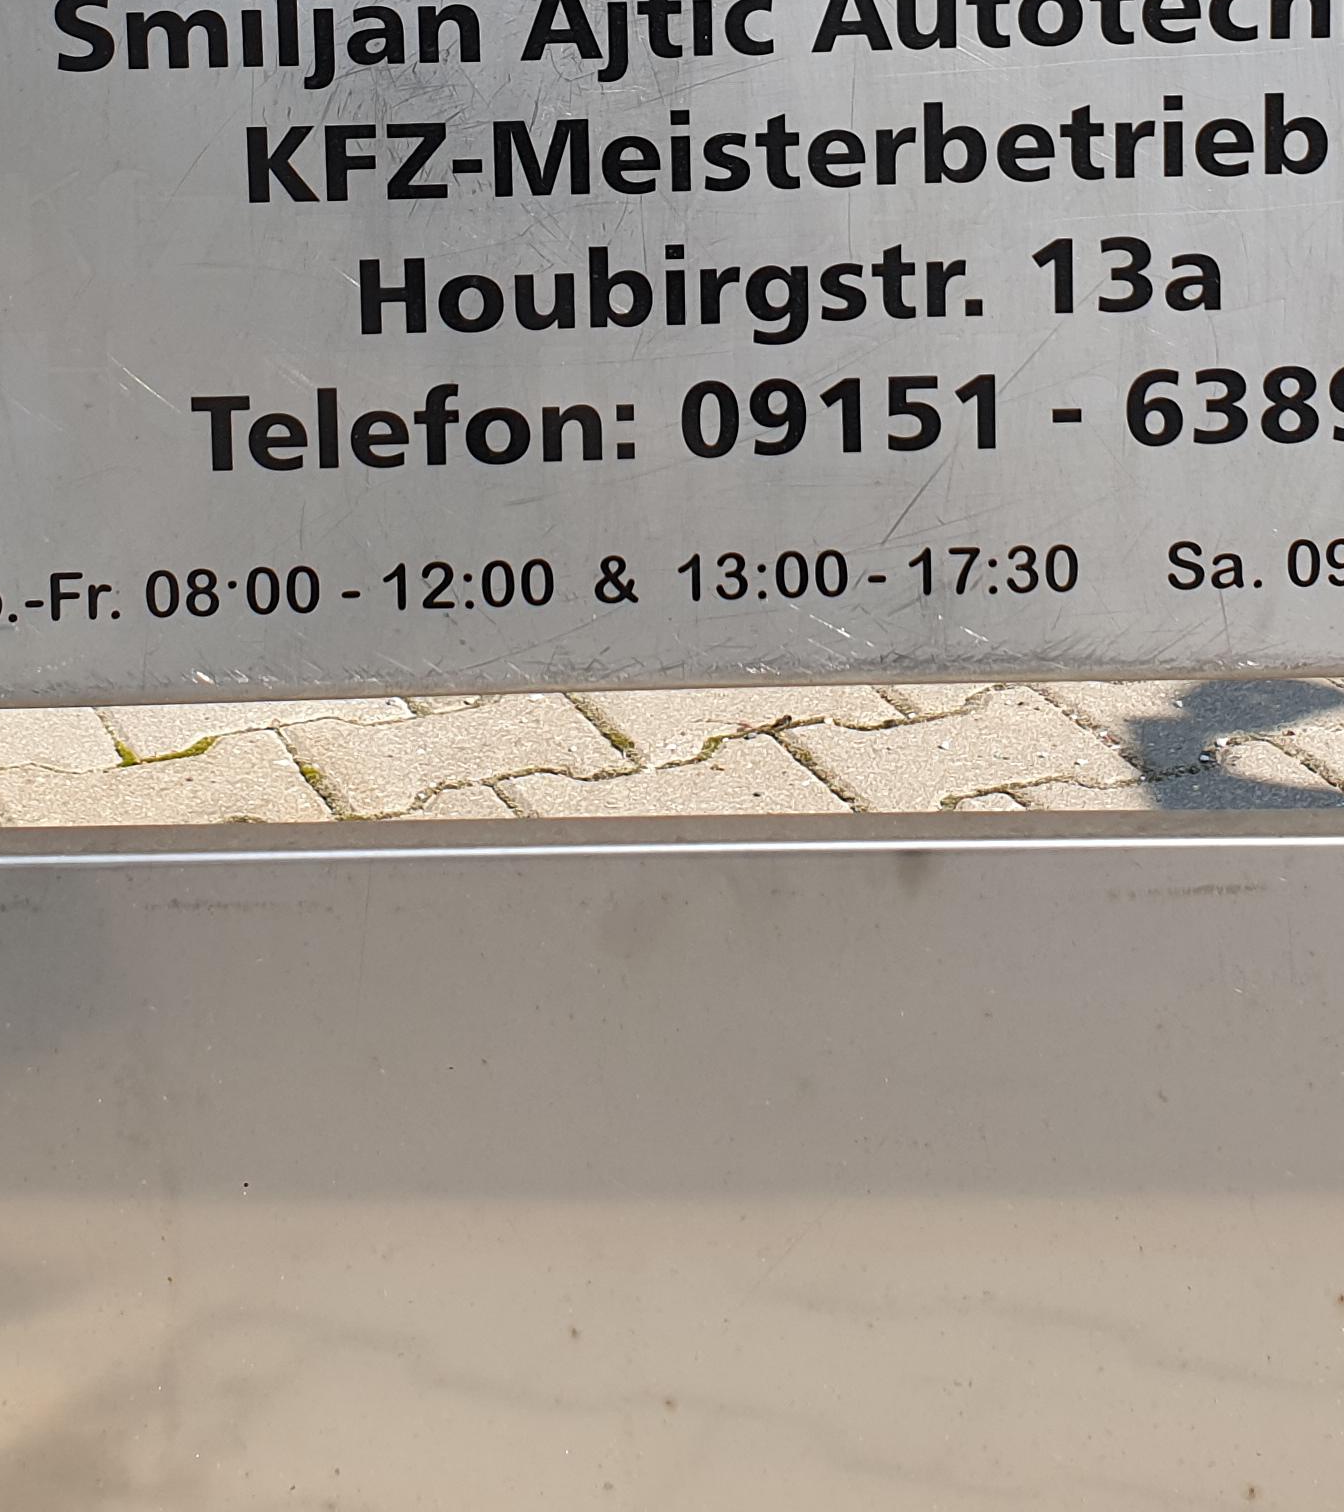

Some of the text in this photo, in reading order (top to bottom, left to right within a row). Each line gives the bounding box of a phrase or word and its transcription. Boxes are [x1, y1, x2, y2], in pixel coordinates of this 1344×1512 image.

[246, 93, 1328, 203] KFZ-Meisterbetrieb
[360, 237, 1221, 345] Houbirgstr. 13a
[191, 384, 635, 471] Telefon:
[682, 375, 996, 458] 09151
[1053, 409, 1081, 423] -
[341, 590, 361, 599] -
[383, 559, 554, 610] 12:00
[595, 556, 638, 603] &
[678, 550, 847, 601] 13:00
[867, 575, 887, 584] -
[909, 545, 1078, 596] 17:30
[1168, 541, 1262, 590] Sa.
